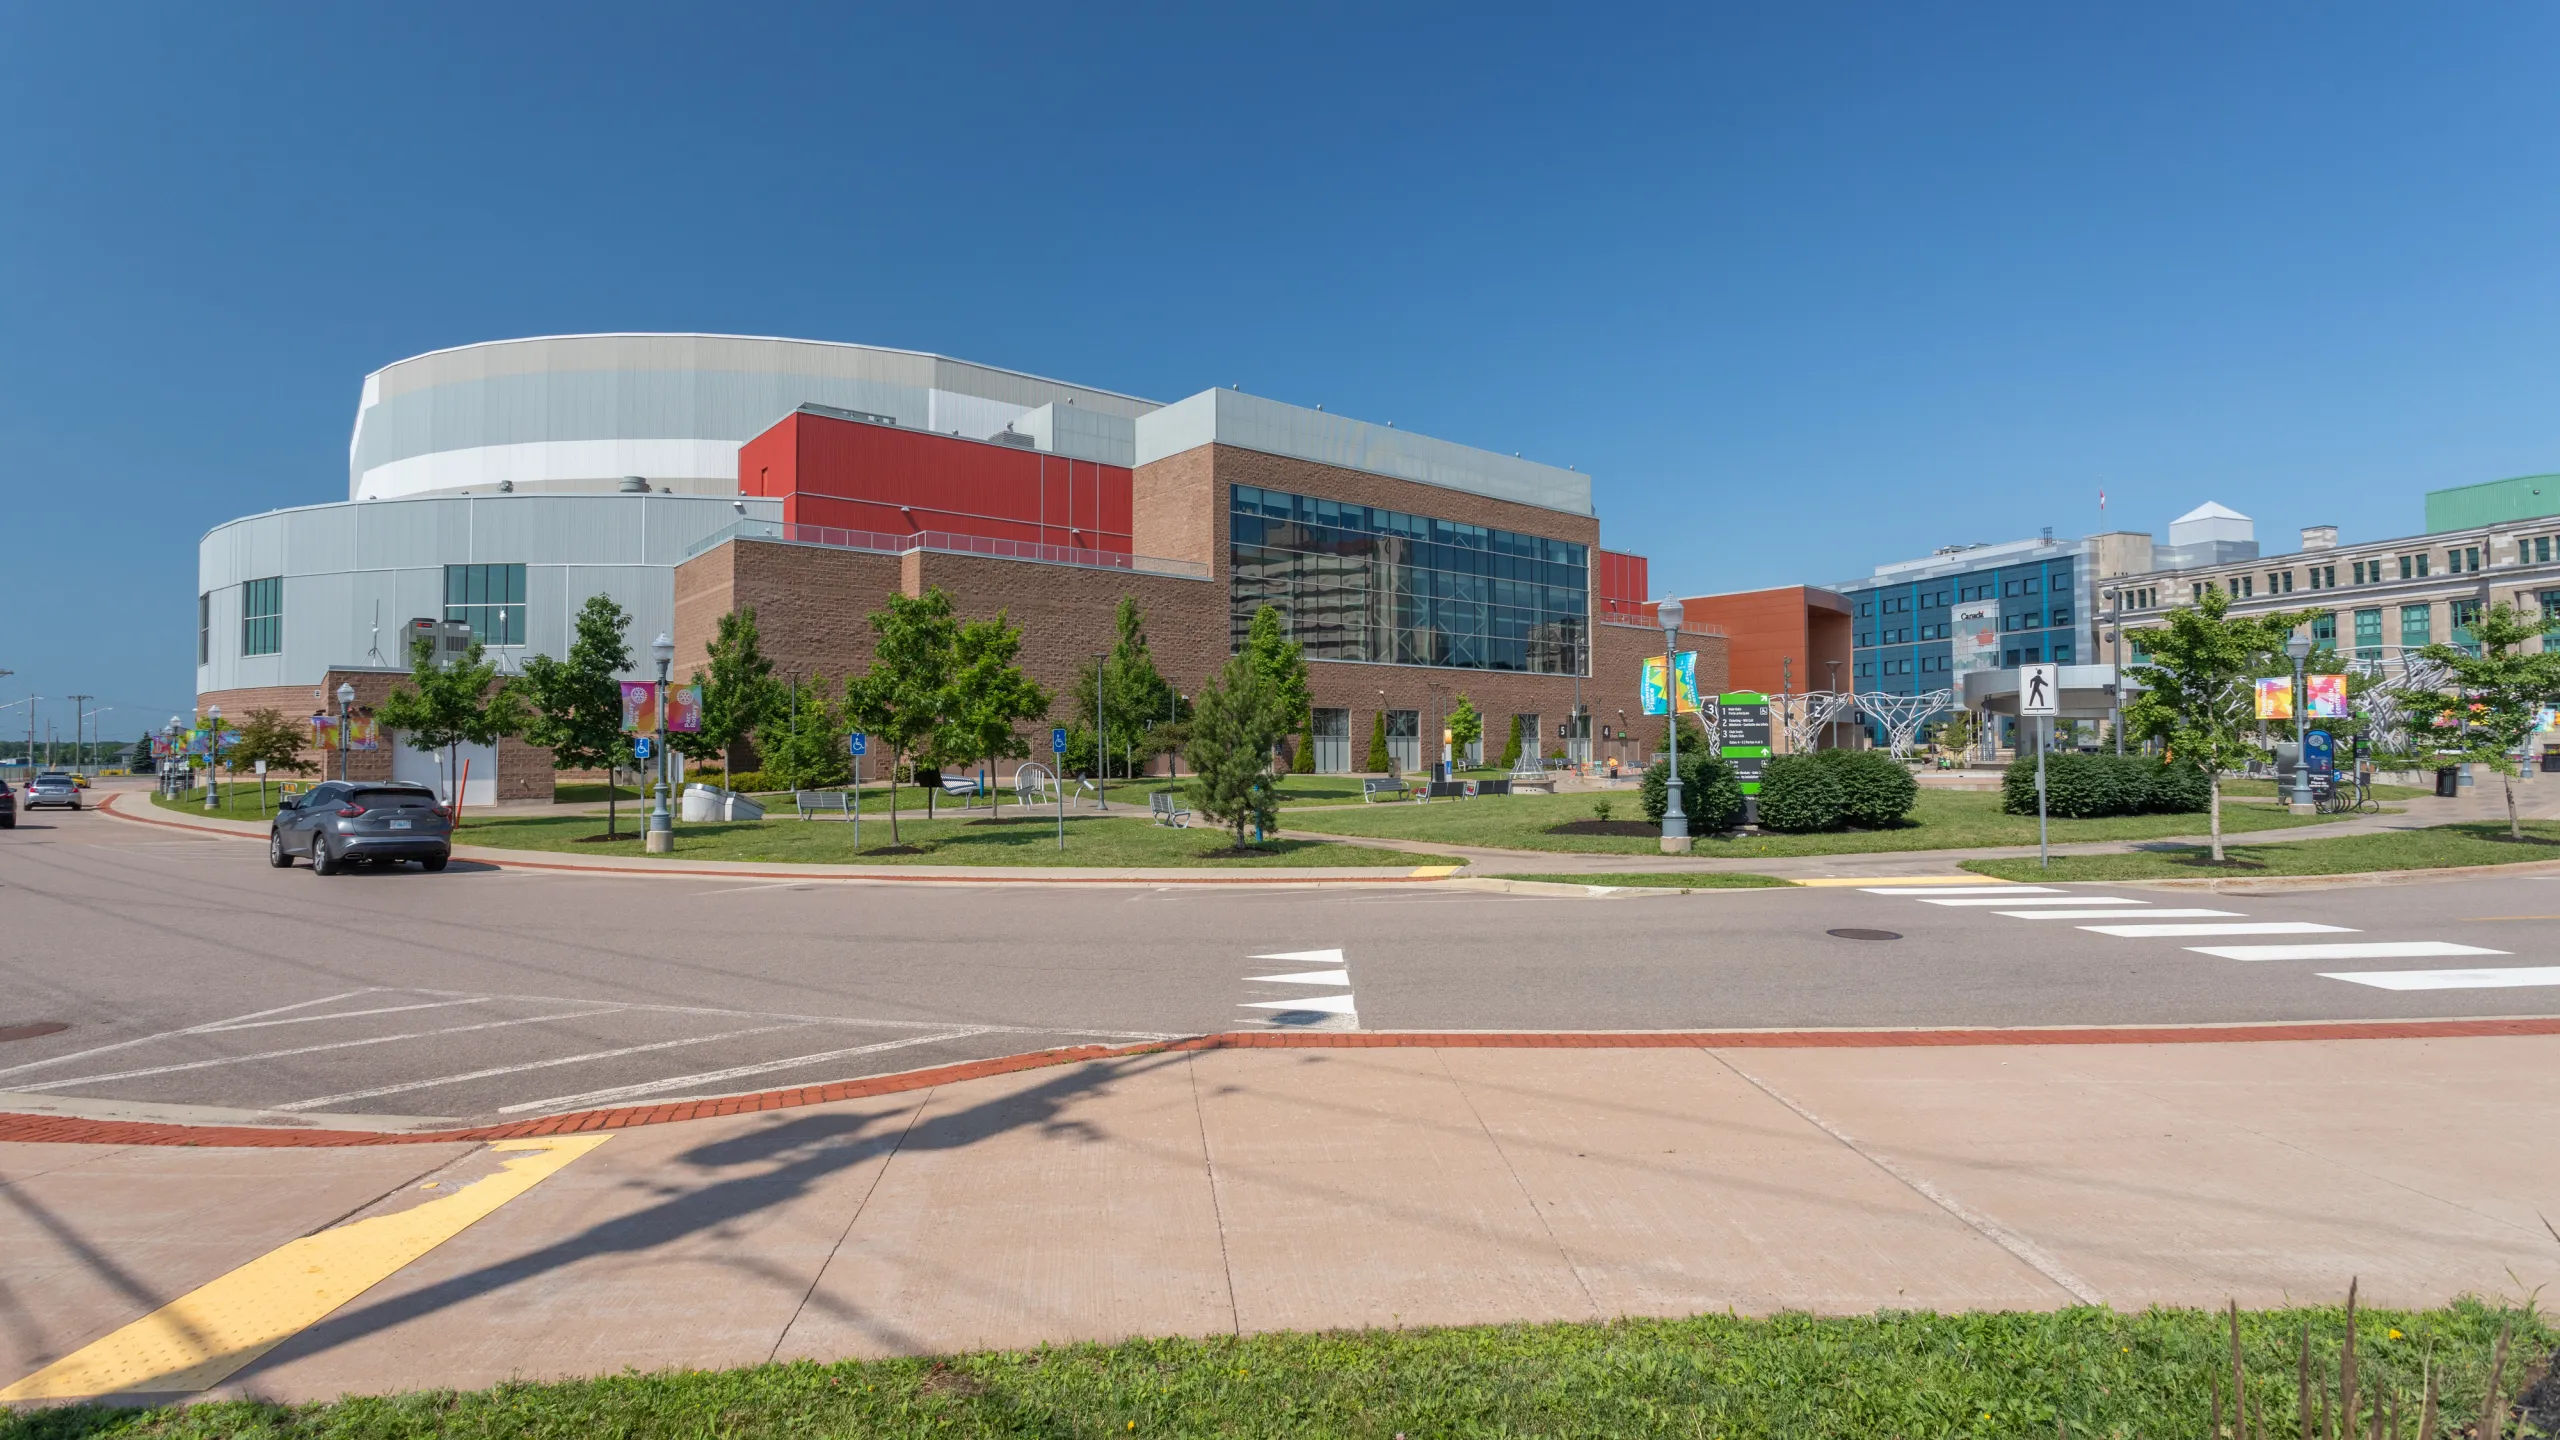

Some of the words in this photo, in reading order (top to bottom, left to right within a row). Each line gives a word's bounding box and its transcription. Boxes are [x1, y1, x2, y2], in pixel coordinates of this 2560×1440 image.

[1961, 610, 1984, 620] Canada
[2334, 678, 2343, 714] centre-ville
[1707, 703, 1715, 714] 3
[1814, 705, 1821, 717] 2
[2327, 697, 2335, 714] Place
[627, 702, 635, 727] Rotary
[632, 710, 640, 727] Park
[690, 704, 699, 728] Rotary
[1856, 713, 1861, 723] 1
[1722, 719, 1727, 727] 2
[1560, 726, 1565, 736] 5
[1604, 727, 1609, 736] 4
[1722, 730, 1727, 738] 3
